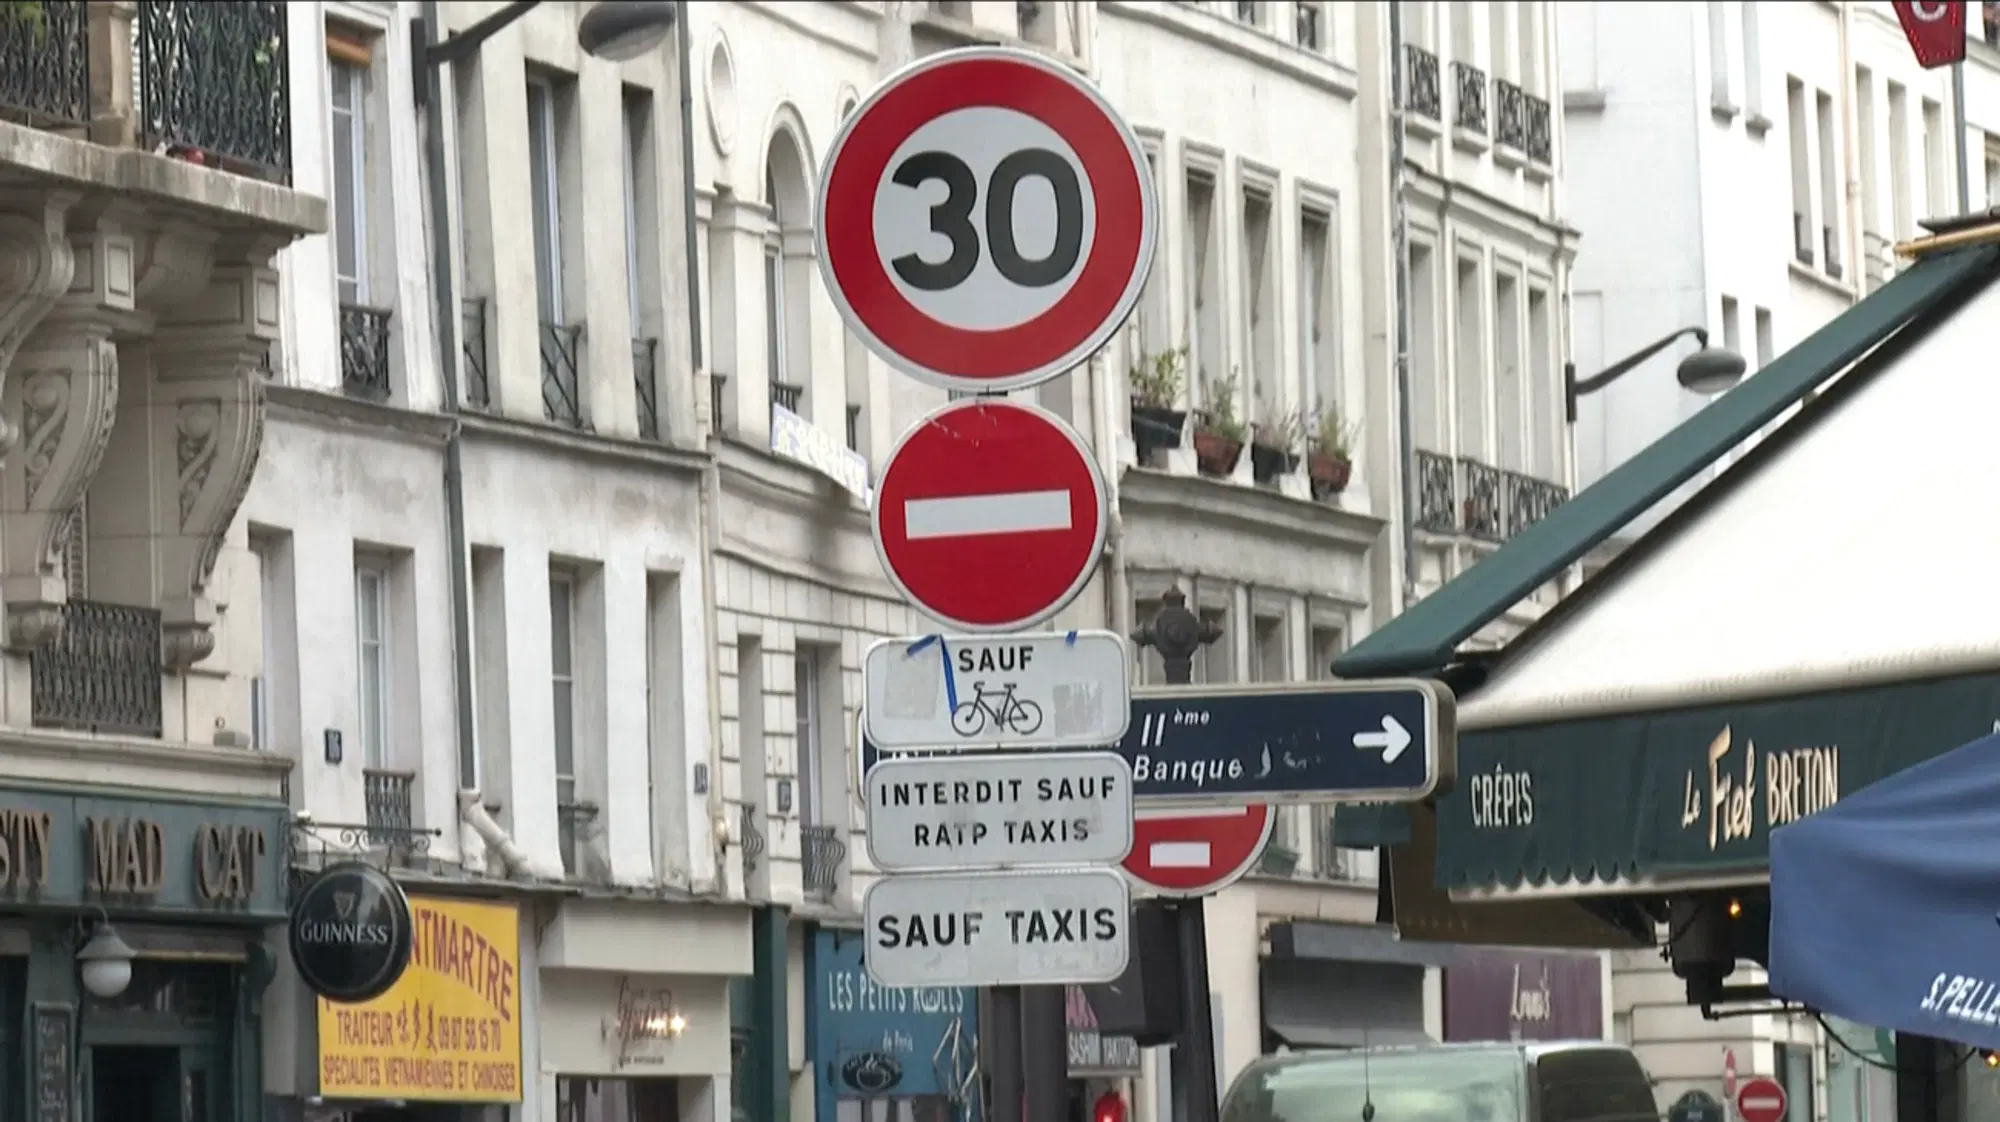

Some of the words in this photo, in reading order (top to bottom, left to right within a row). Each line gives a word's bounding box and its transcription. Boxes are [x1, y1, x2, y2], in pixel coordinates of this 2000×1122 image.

[892, 147, 1084, 291] 30
[958, 646, 1034, 672] SAUF
[1133, 754, 1242, 787] Banque
[1682, 768, 1701, 829] Le
[1709, 722, 1756, 852] Fief
[1767, 745, 1838, 826] BRETON
[881, 779, 1022, 806] INTERDIT
[1037, 776, 1115, 801] SAUF
[1471, 762, 1533, 828] CRÊPES
[914, 822, 987, 847] RATP
[1004, 818, 1089, 845] TAXIS
[85, 816, 164, 893] MAD
[199, 821, 266, 899] CAT
[300, 919, 388, 944] GUINNESS
[878, 912, 983, 948] SAUF
[1005, 908, 1117, 944] TAXIS
[828, 972, 853, 1012] LES
[337, 1011, 394, 1046] TRAITEUR
[458, 1061, 468, 1092] ET
